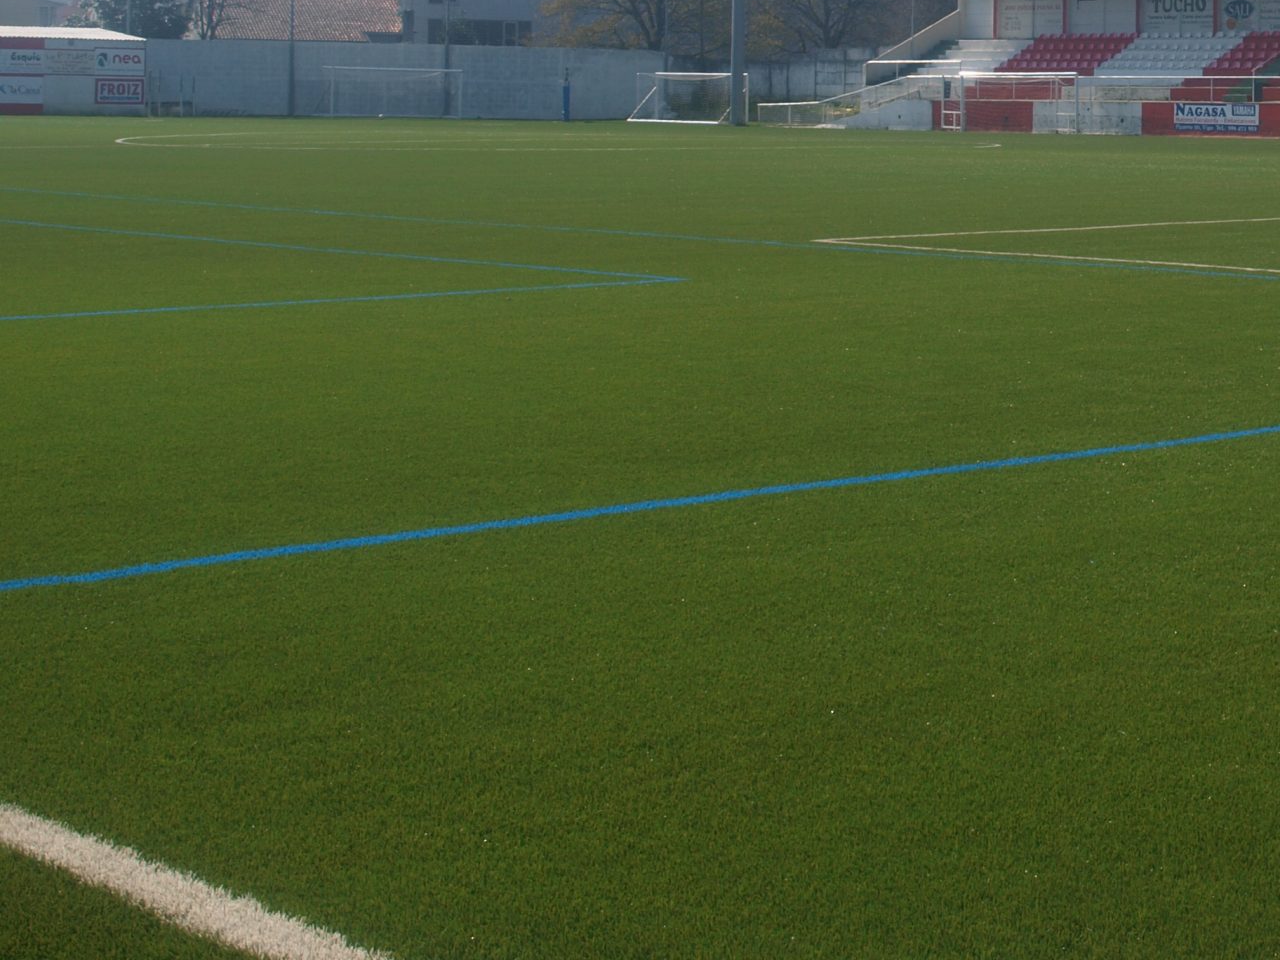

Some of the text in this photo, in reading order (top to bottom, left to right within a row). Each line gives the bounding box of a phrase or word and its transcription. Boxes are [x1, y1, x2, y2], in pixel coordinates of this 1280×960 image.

[112, 54, 142, 65] nea
[99, 83, 140, 96] FROIZ
[1175, 103, 1227, 117] NAGASA
